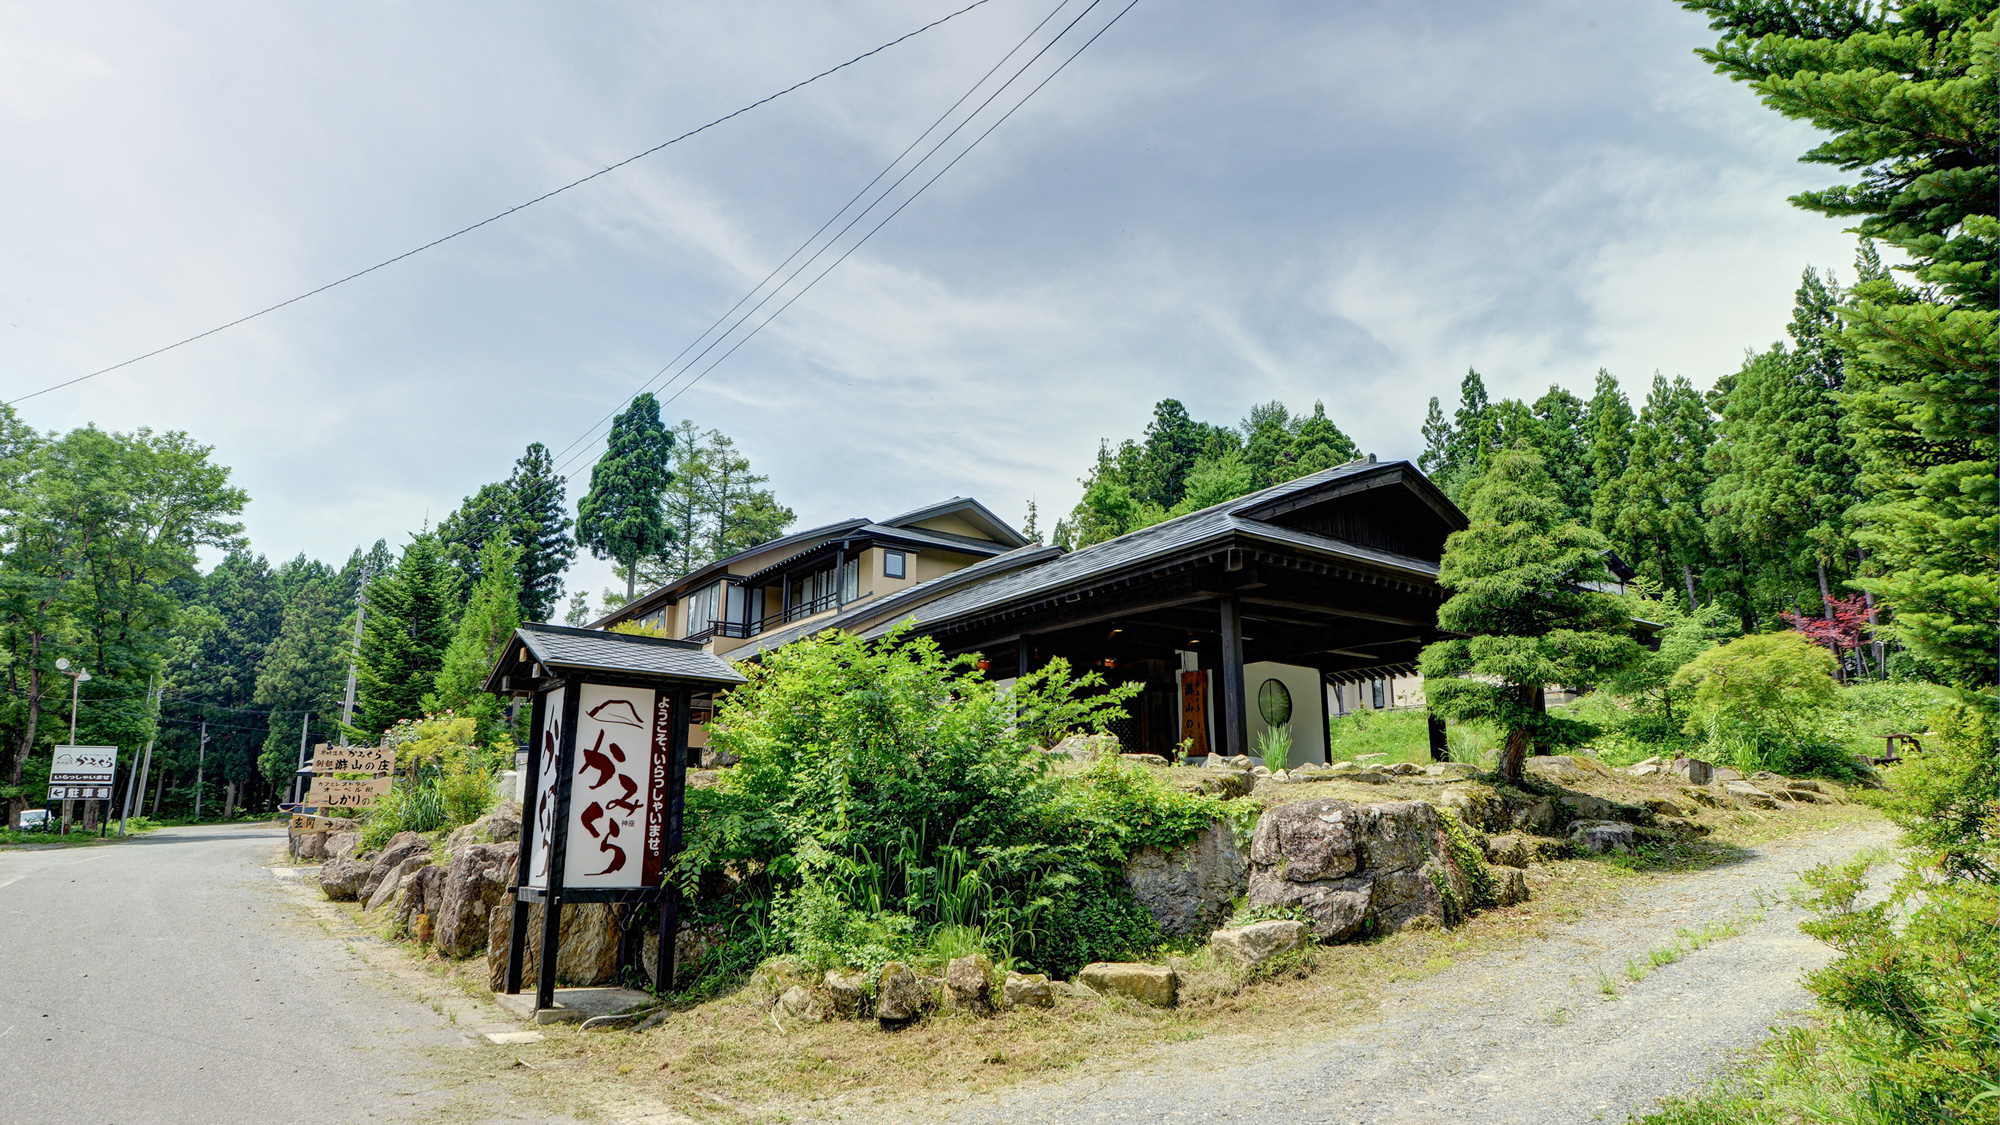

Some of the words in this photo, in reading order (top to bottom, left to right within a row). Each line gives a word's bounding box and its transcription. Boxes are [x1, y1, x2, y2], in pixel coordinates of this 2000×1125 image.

[75, 754, 113, 768] かみくら
[347, 749, 382, 760] かみくら
[648, 696, 670, 857] ようこそ、いらっしゃいませ。
[67, 787, 108, 798] 駐車場
[578, 729, 644, 876] かみくら
